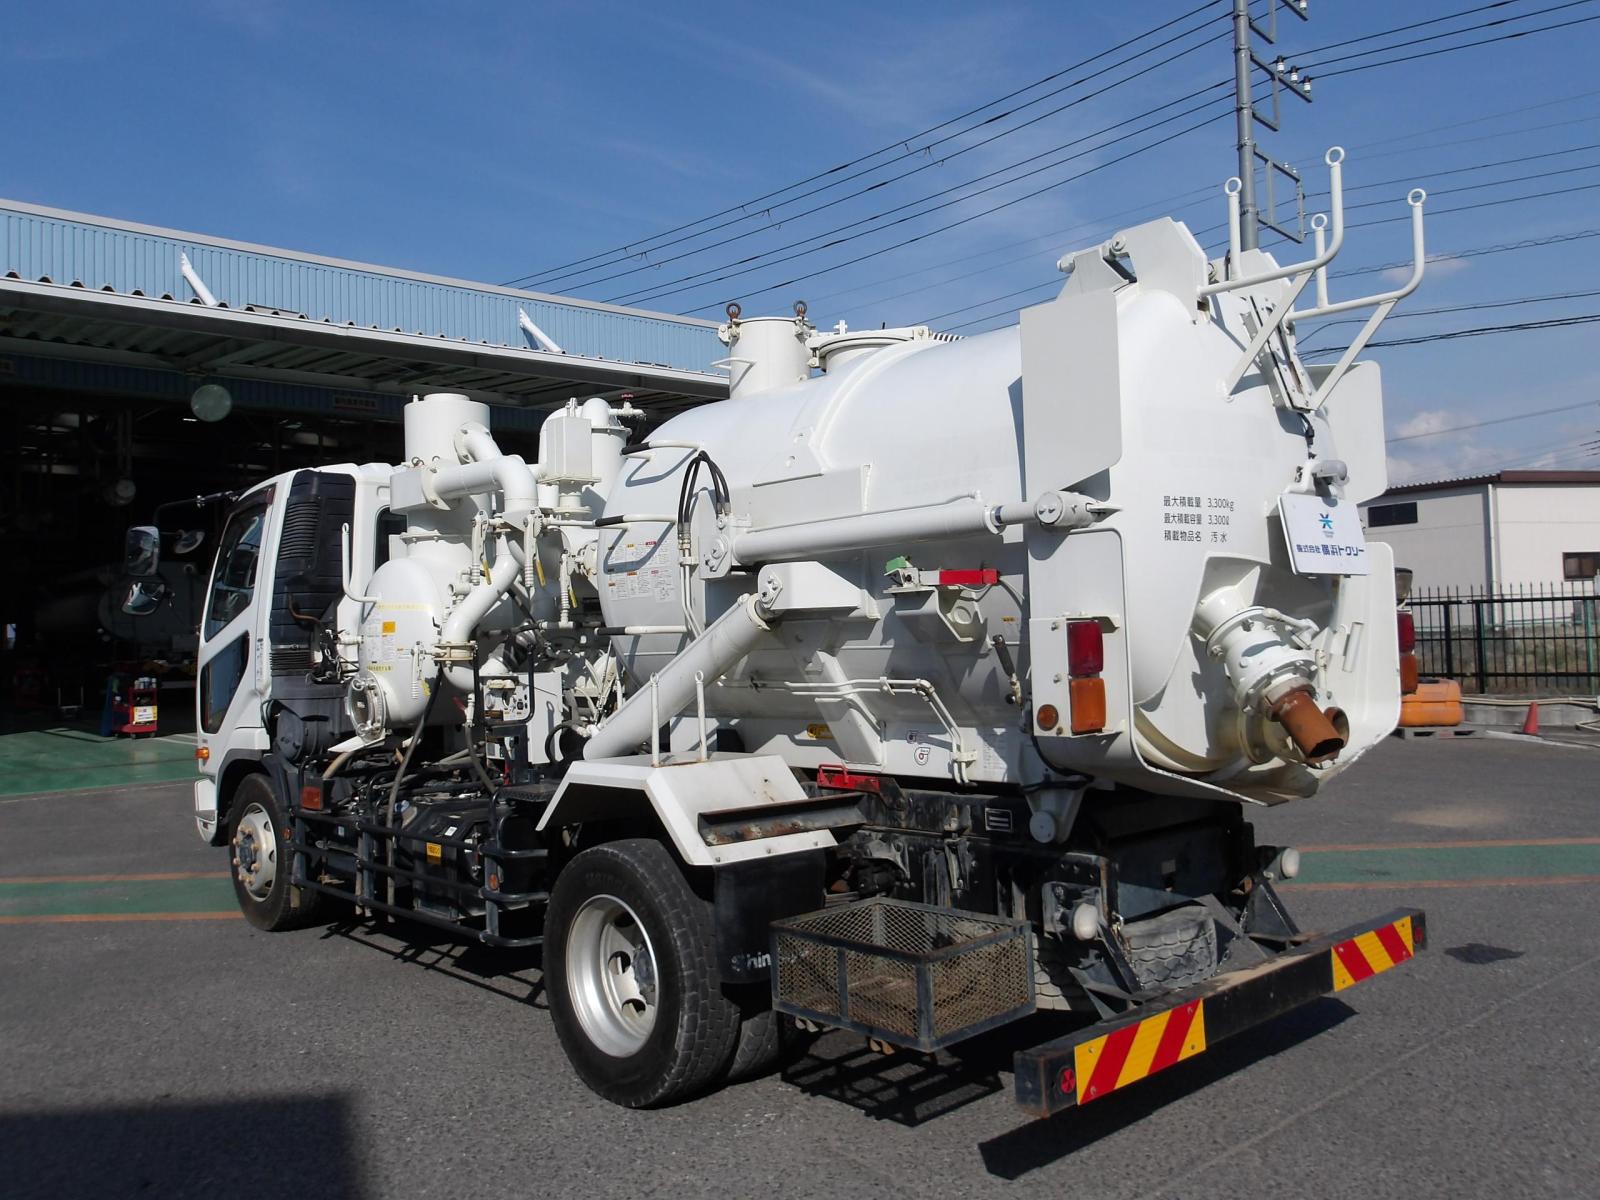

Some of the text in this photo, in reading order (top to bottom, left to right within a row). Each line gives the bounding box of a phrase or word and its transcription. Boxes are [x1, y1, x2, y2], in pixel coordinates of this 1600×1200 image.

[1163, 495, 1201, 508] 最大積載量
[1163, 512, 1202, 525] 最大積載容量
[1164, 529, 1202, 542] 積載物品名
